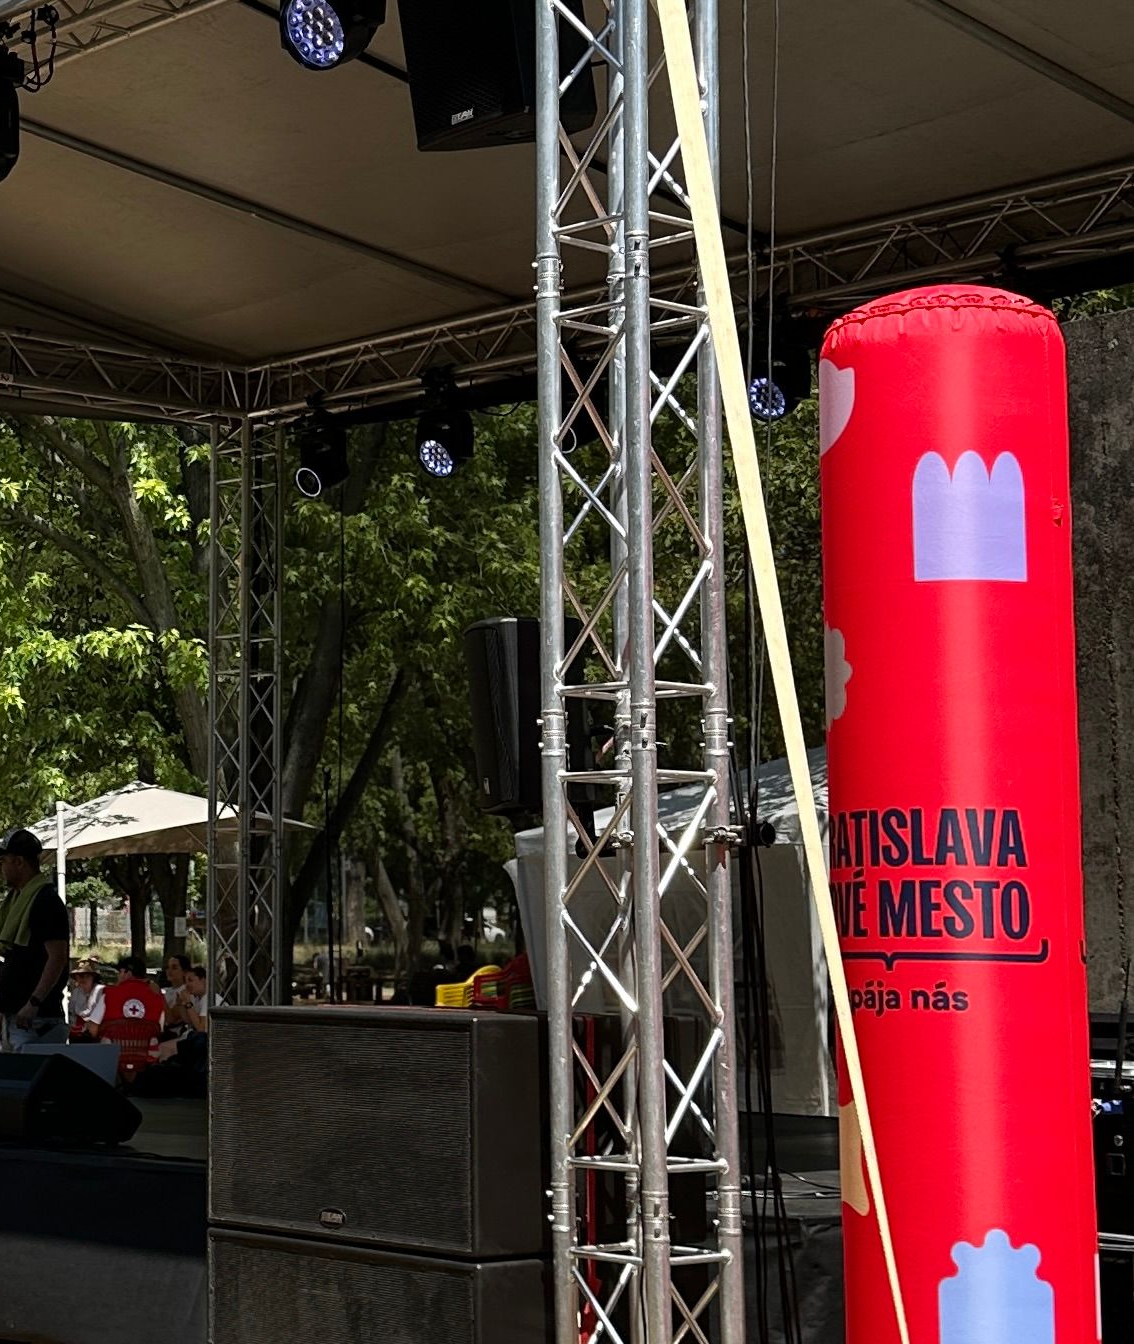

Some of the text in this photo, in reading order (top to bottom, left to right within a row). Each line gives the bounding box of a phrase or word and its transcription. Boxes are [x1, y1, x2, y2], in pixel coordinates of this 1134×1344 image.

[878, 879, 1031, 940] MESTO
[850, 980, 969, 1018] pája nás
